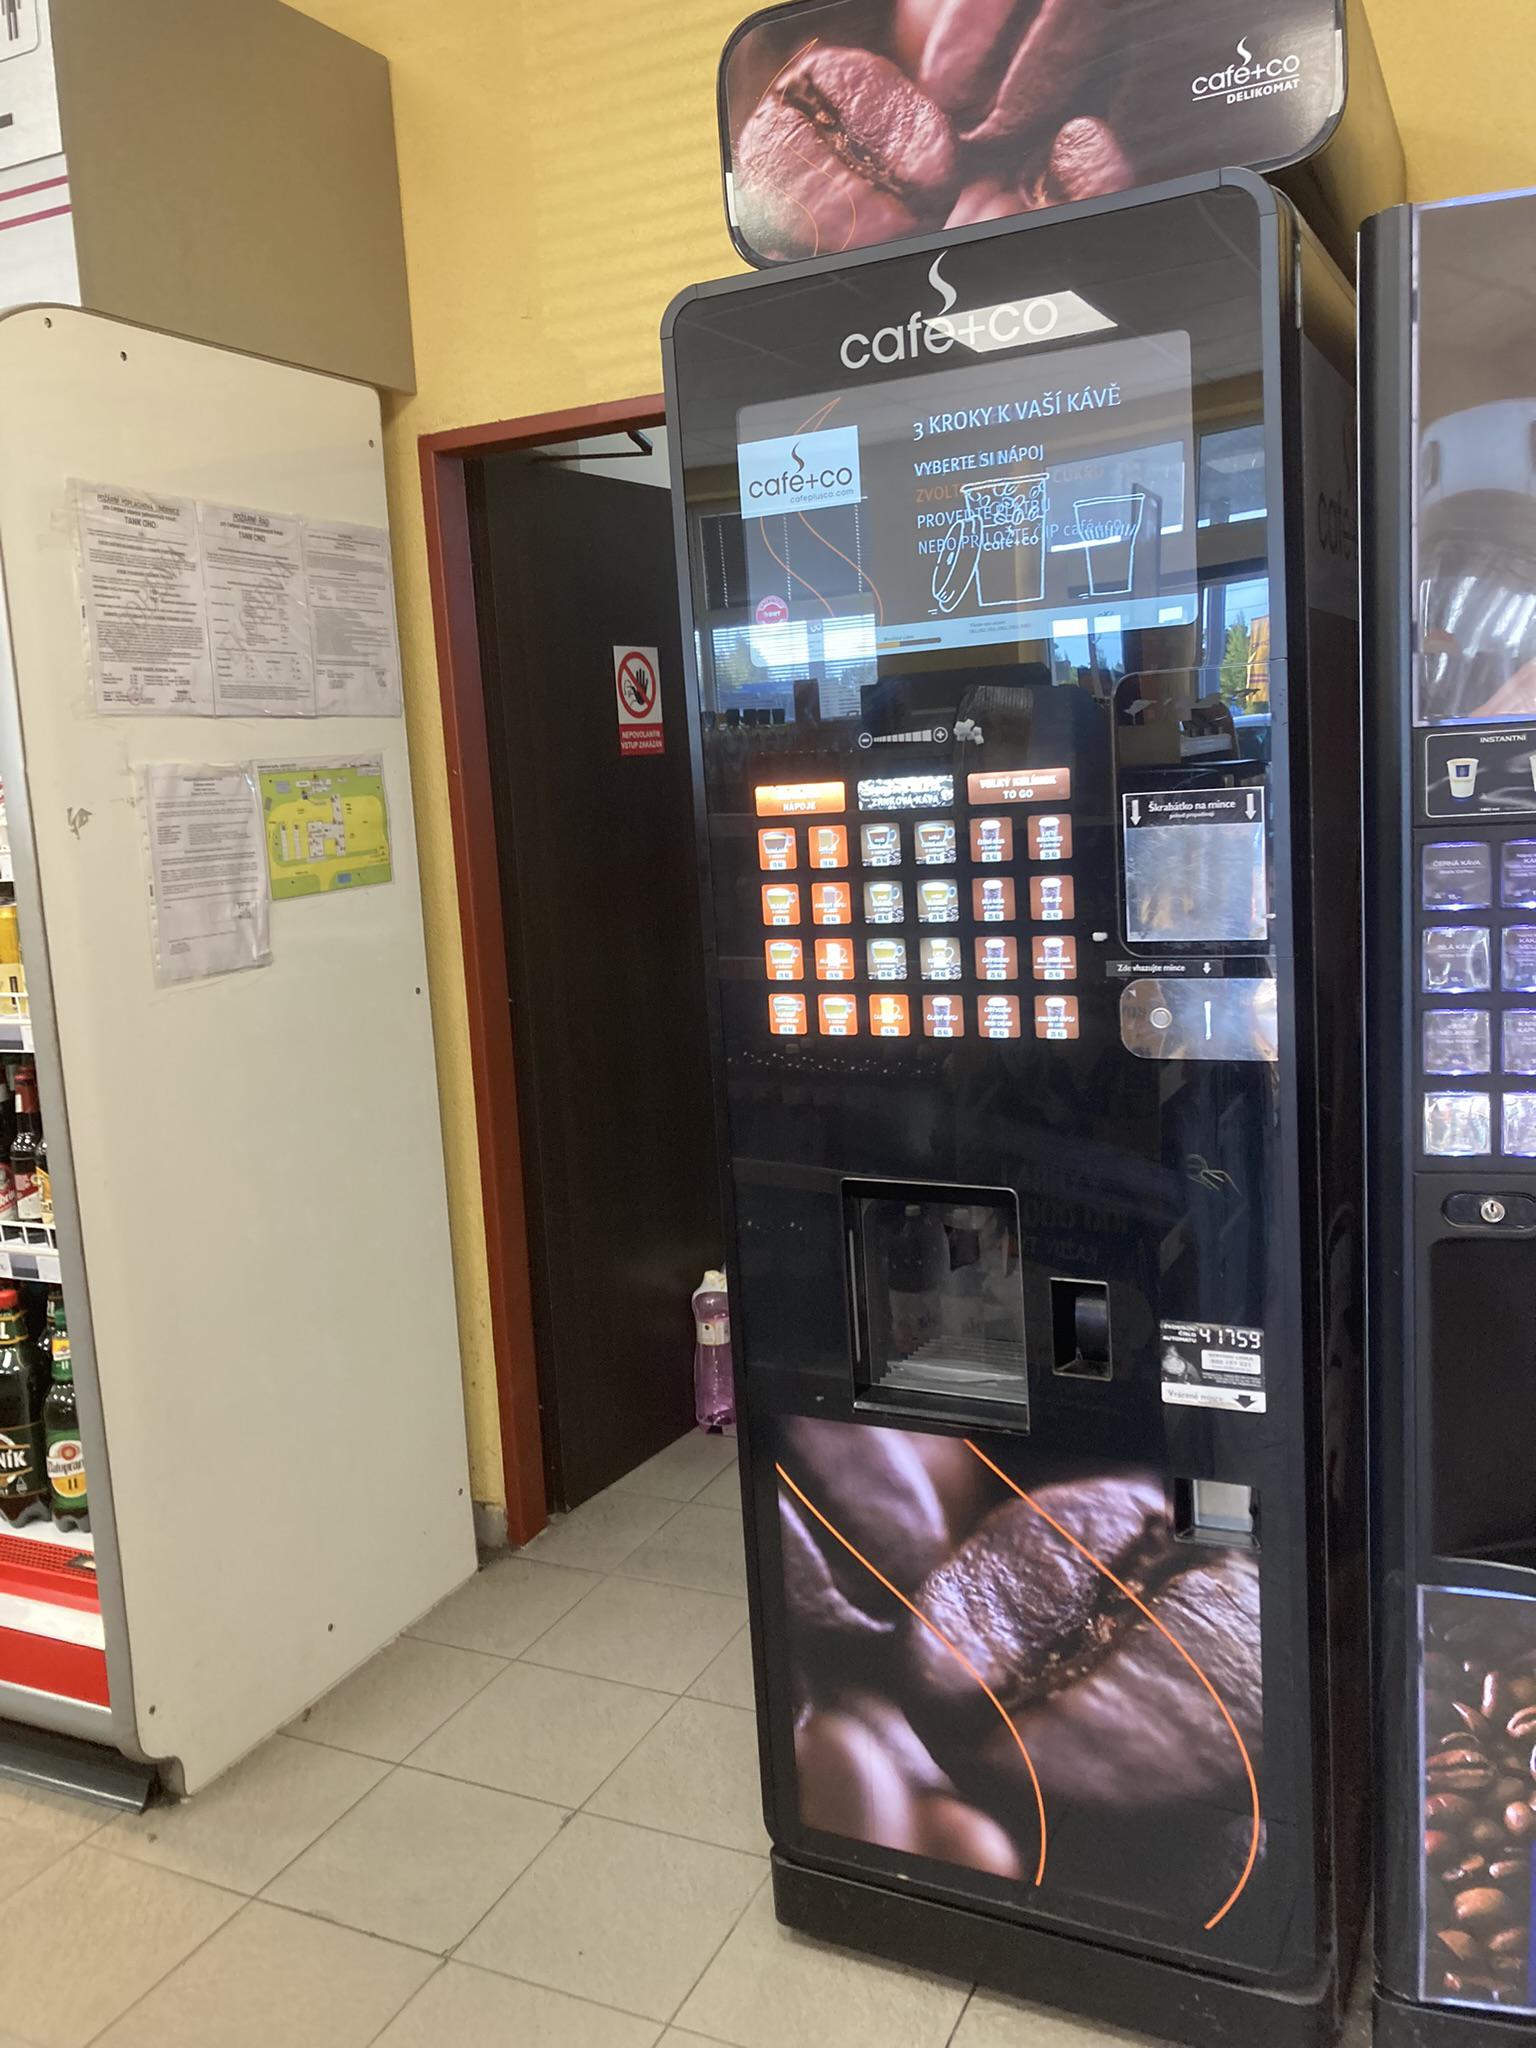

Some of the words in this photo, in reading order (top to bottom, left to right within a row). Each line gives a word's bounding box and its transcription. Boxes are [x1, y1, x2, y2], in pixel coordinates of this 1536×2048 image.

[1226, 79, 1299, 104] DELIKOMAT
[912, 423, 924, 441] 3
[929, 406, 992, 435] KROKY
[997, 403, 1010, 423] K
[1014, 391, 1062, 420] VAŠÍ
[1067, 382, 1121, 412] KÁVĚ
[913, 455, 975, 477] VYBERTE
[978, 452, 994, 467] SI
[997, 444, 1045, 464] NÁPOJ
[915, 481, 964, 503] ZVOLT
[1003, 790, 1016, 799] TO
[1019, 789, 1034, 798] GO
[1148, 800, 1193, 812] Škrabátko
[1208, 800, 1236, 809] mince
[1163, 964, 1185, 972] mince
[1199, 1328, 1261, 1349] 41759
